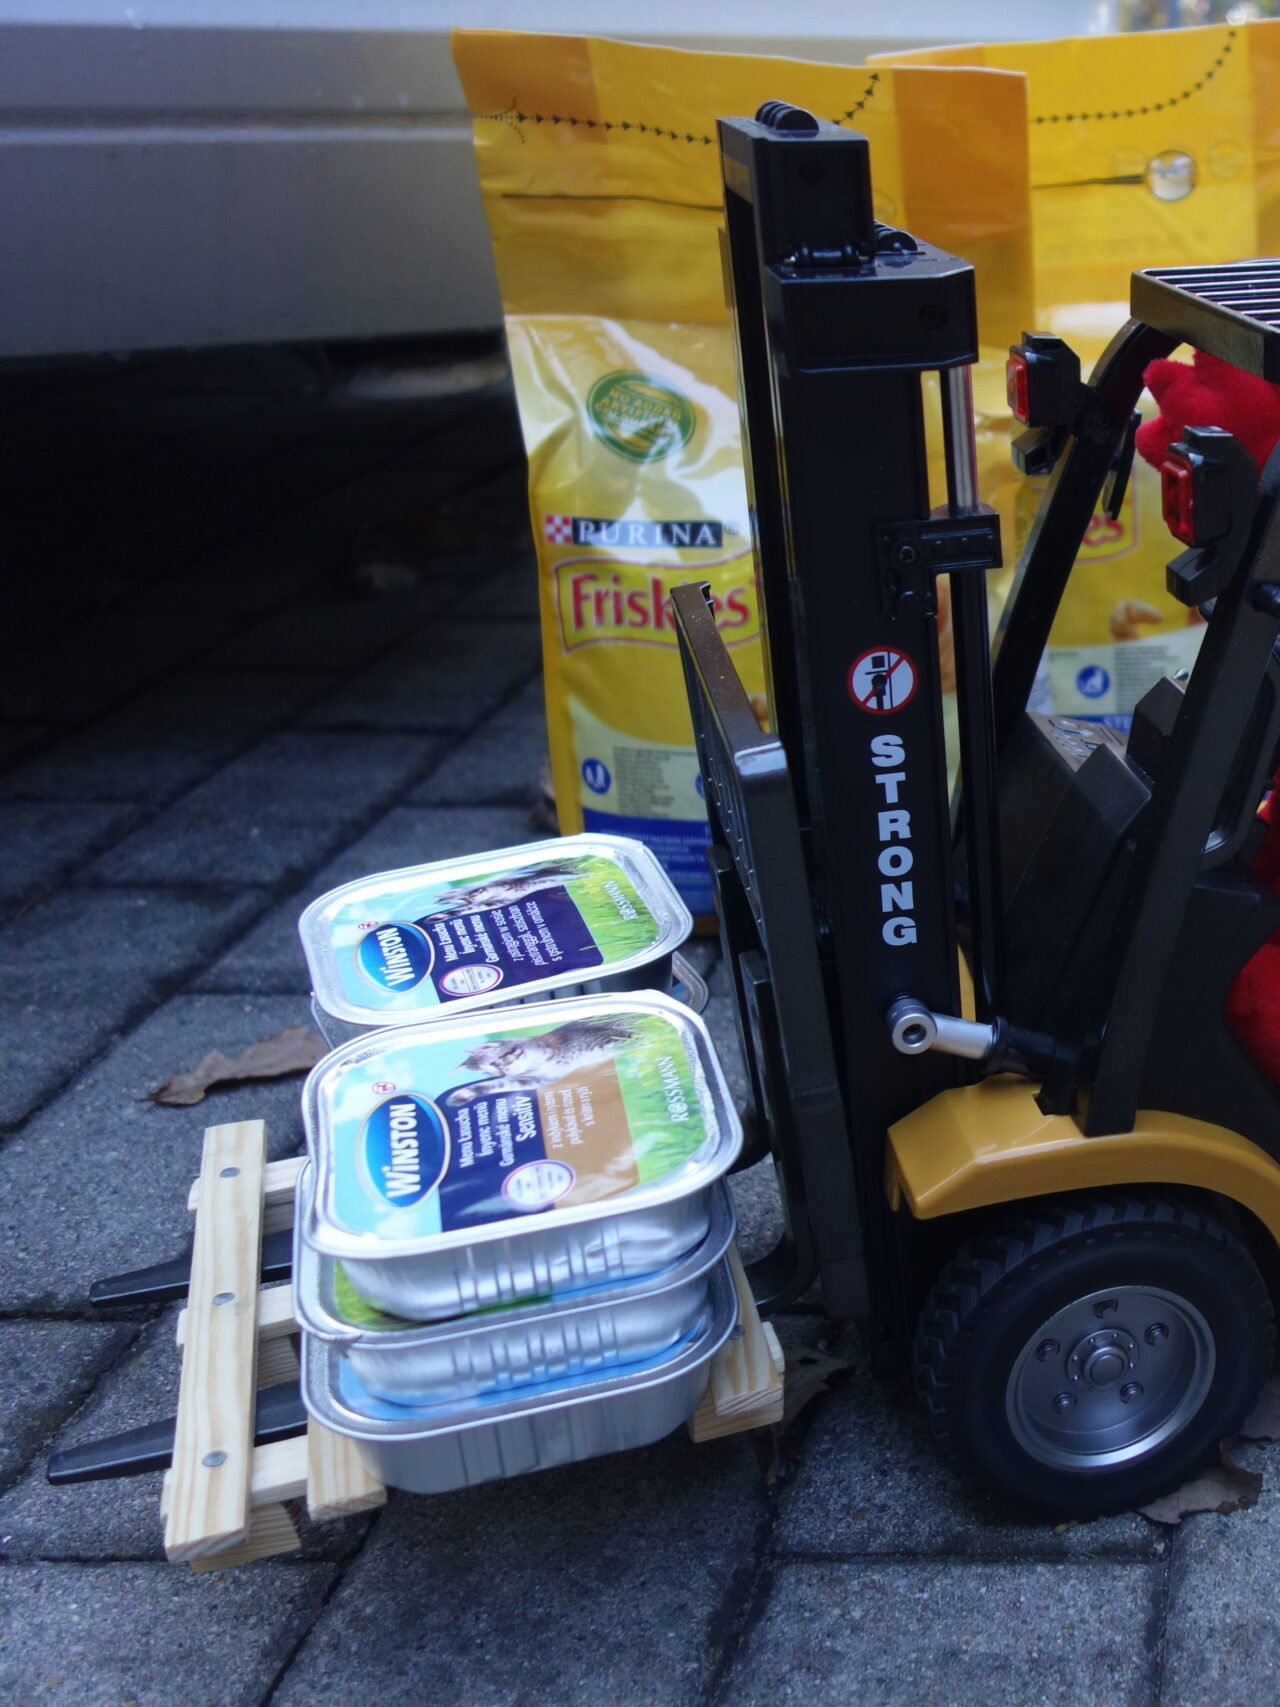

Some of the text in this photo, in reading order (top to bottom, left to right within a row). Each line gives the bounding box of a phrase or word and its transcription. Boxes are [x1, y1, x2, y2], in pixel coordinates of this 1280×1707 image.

[578, 520, 717, 545] PURINA
[571, 573, 750, 630] Frisks
[870, 734, 918, 946] STRONG
[601, 880, 640, 921] ROSSMANN
[470, 914, 486, 935] menu
[500, 924, 509, 933] w
[444, 944, 460, 962] Menu
[538, 926, 564, 958] pstruhem
[655, 1055, 690, 1122] ROSSMANN
[496, 1098, 510, 1123] menu
[511, 1096, 537, 1142] Sensitiv
[459, 1141, 476, 1169] Menu
